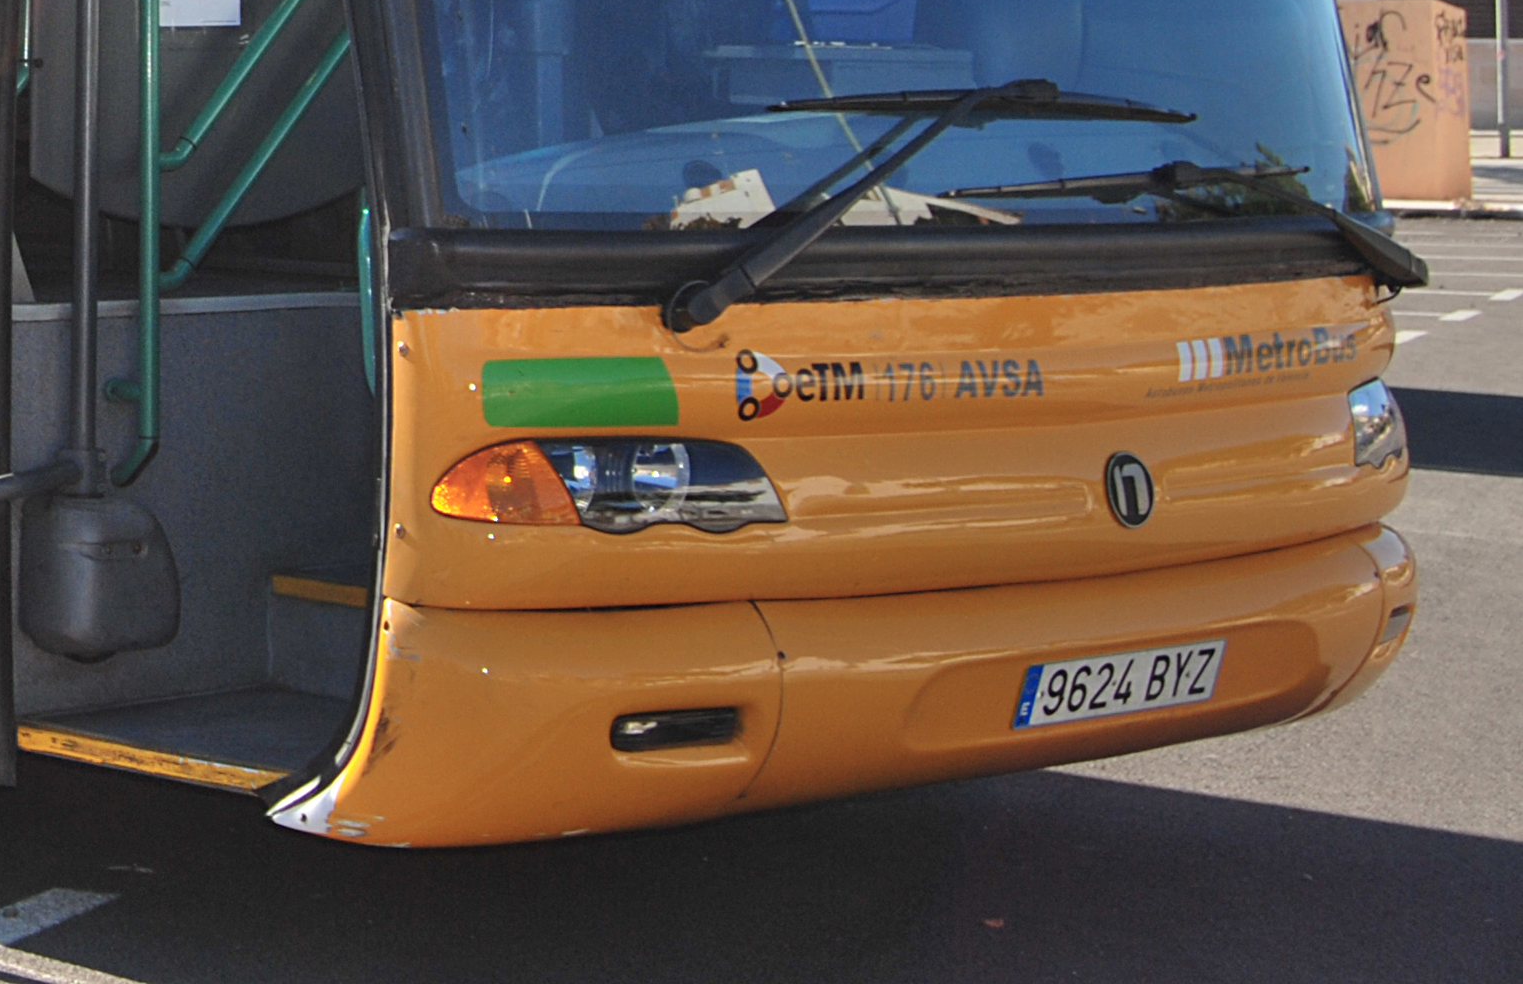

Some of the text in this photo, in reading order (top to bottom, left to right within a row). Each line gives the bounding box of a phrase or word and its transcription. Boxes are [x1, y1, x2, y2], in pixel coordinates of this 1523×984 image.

[1223, 326, 1358, 376] MetroBus
[953, 359, 1046, 400] AVSA
[1042, 648, 1217, 716] 9624 BYZ
